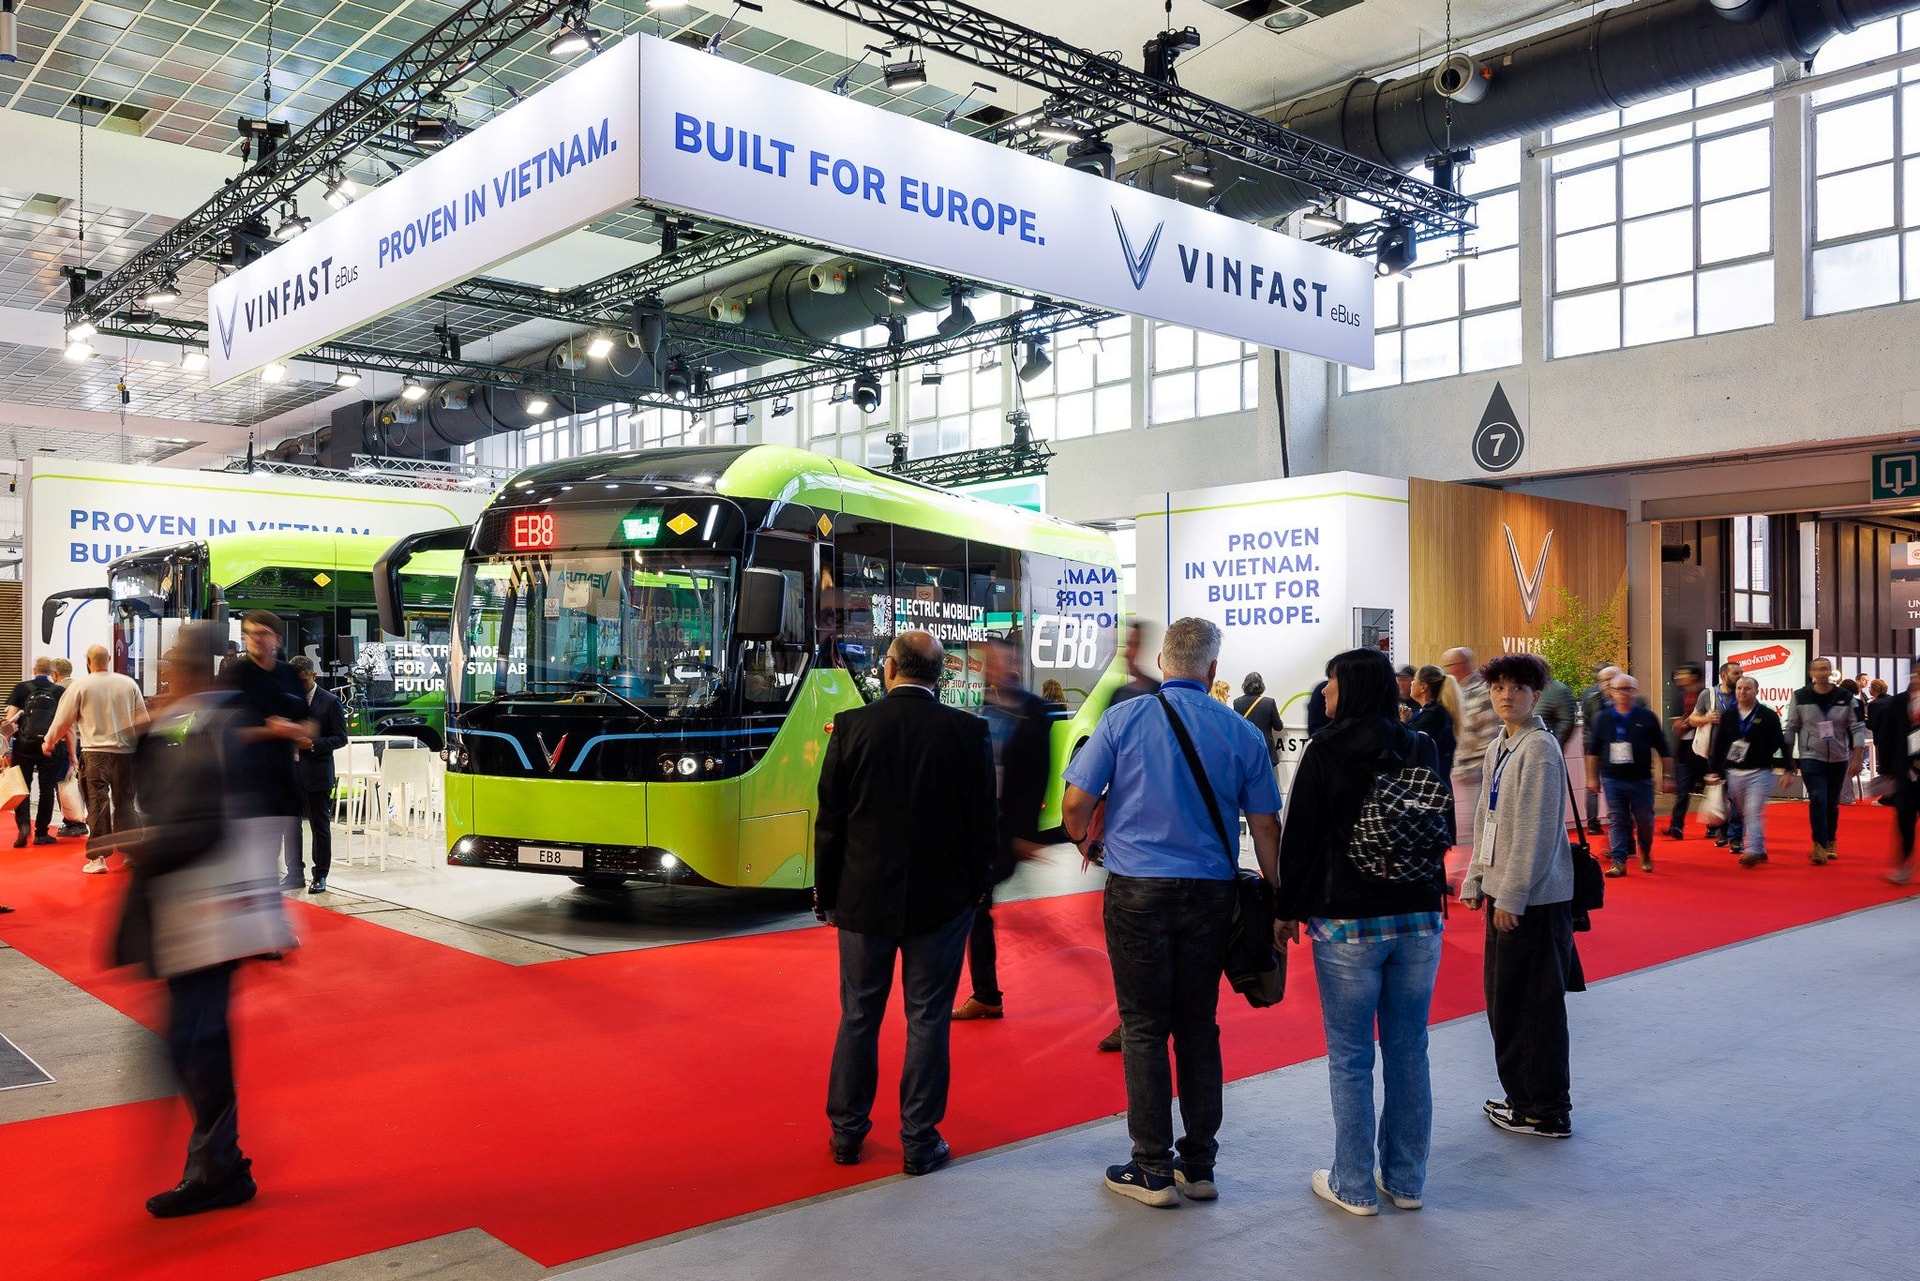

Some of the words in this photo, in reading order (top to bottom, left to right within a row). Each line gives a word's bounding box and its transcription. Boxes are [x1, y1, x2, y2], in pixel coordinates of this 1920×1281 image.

[675, 112, 795, 178] BUILT
[810, 150, 886, 205] FOR
[900, 176, 1045, 246] EUROPE.
[379, 200, 457, 268] PROVEN
[465, 184, 485, 225] IN
[493, 118, 617, 208] VIETNAM.
[245, 256, 332, 332] VINFAST
[335, 265, 358, 289] eBus
[1178, 244, 1327, 317] VINFAST
[1330, 304, 1360, 327] eBus
[1490, 433, 1506, 457] 7
[70, 509, 196, 536] PROVEN
[209, 518, 236, 536] IN
[515, 514, 553, 547] EB8
[1228, 527, 1319, 552] PROVEN
[70, 542, 148, 564] BUI
[1185, 562, 1205, 579] IN
[1212, 554, 1320, 578] VIETNAM.
[1208, 582, 1267, 602] BUILT
[1275, 579, 1320, 599] FOR
[894, 598, 941, 618] ELECTRIC
[943, 602, 984, 622] MOBILITY
[1225, 605, 1320, 627] EUROPE.
[928, 623, 988, 642] SUSTAINABLE
[1031, 613, 1099, 669] EB8
[395, 643, 452, 657] ELECTR
[395, 661, 425, 674] FOR
[429, 661, 442, 674] A
[395, 678, 446, 691] FUTUR
[540, 850, 561, 864] EB8
